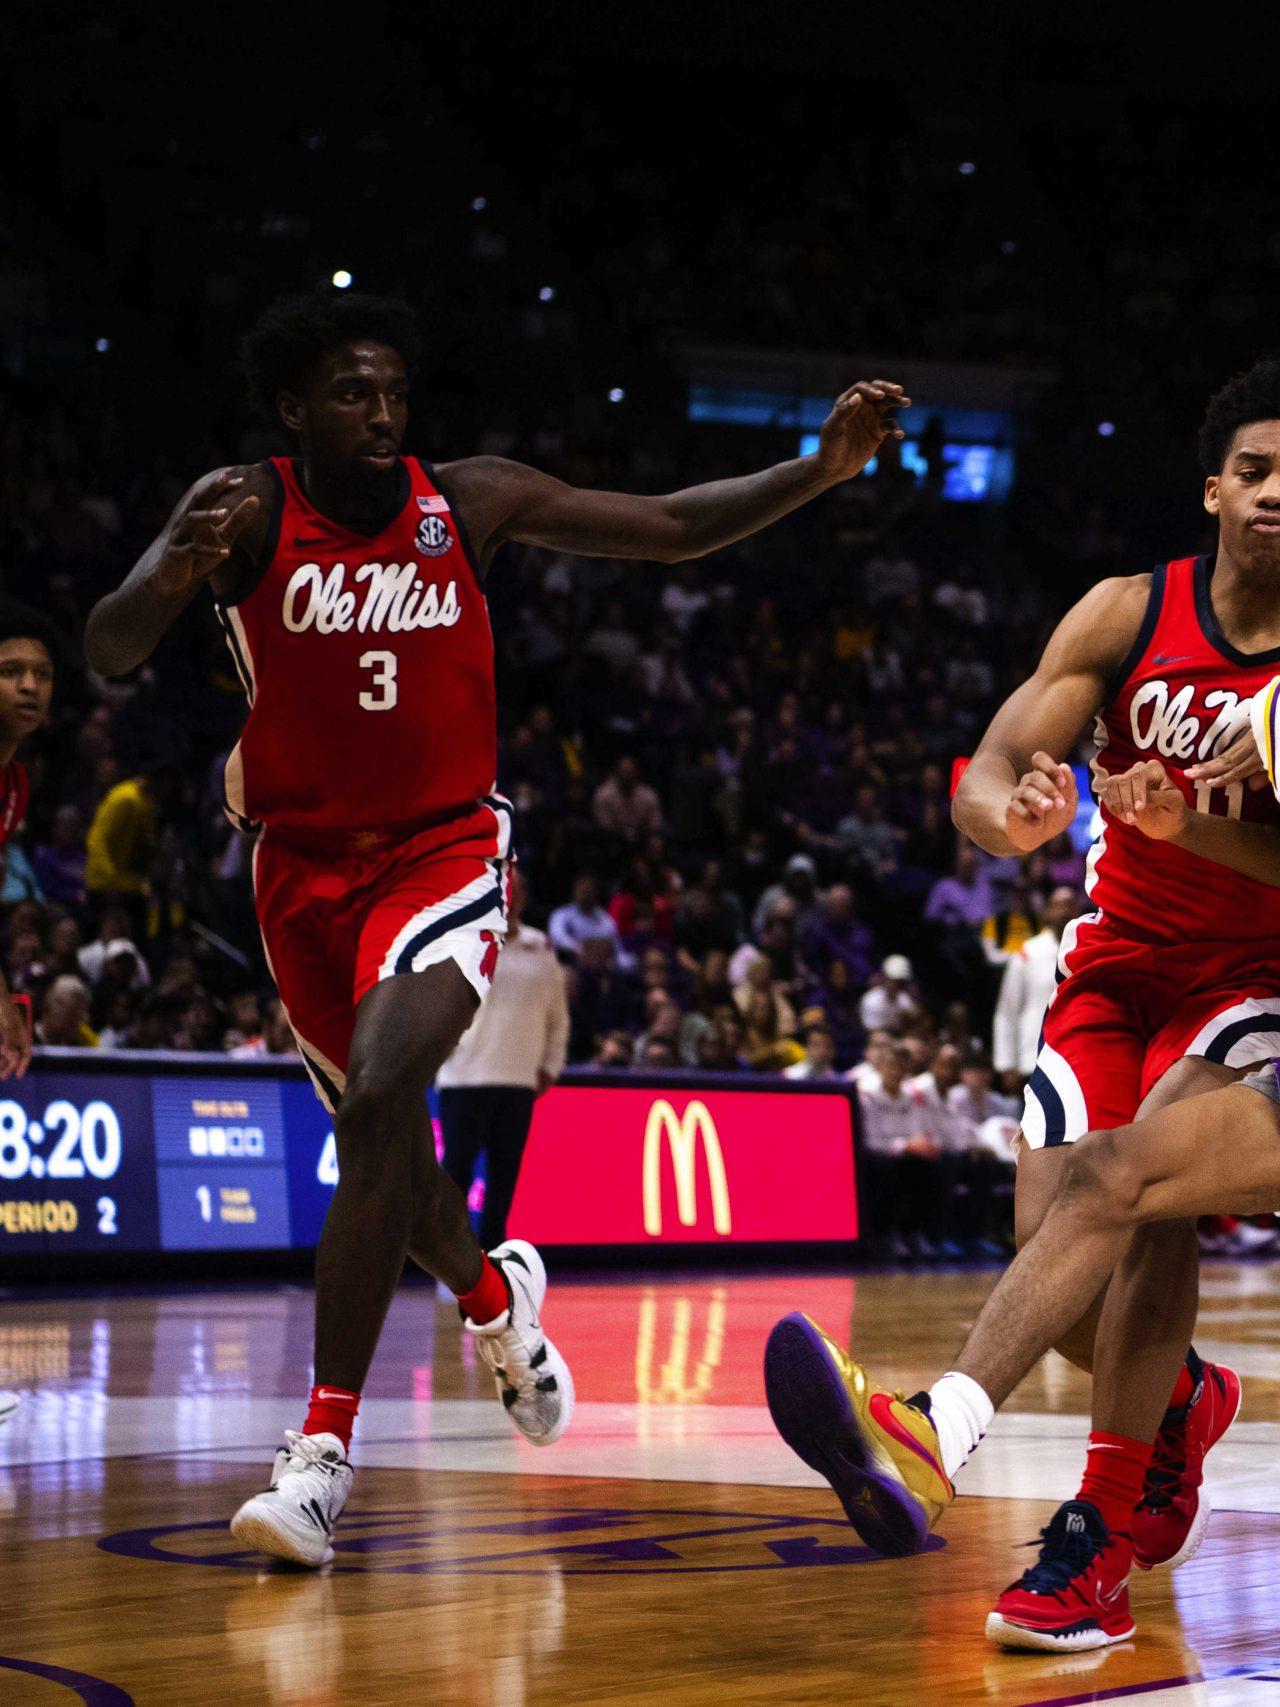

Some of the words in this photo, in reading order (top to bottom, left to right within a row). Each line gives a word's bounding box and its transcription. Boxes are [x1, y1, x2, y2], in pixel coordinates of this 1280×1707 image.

[419, 516, 447, 547] SEC
[282, 562, 356, 635] Ole
[354, 561, 462, 634] Miss
[358, 649, 398, 711] 3
[1130, 680, 1200, 759] Ole
[0, 1199, 78, 1233] ERIOD
[97, 1196, 118, 1234] 2
[196, 1185, 211, 1222] 1
